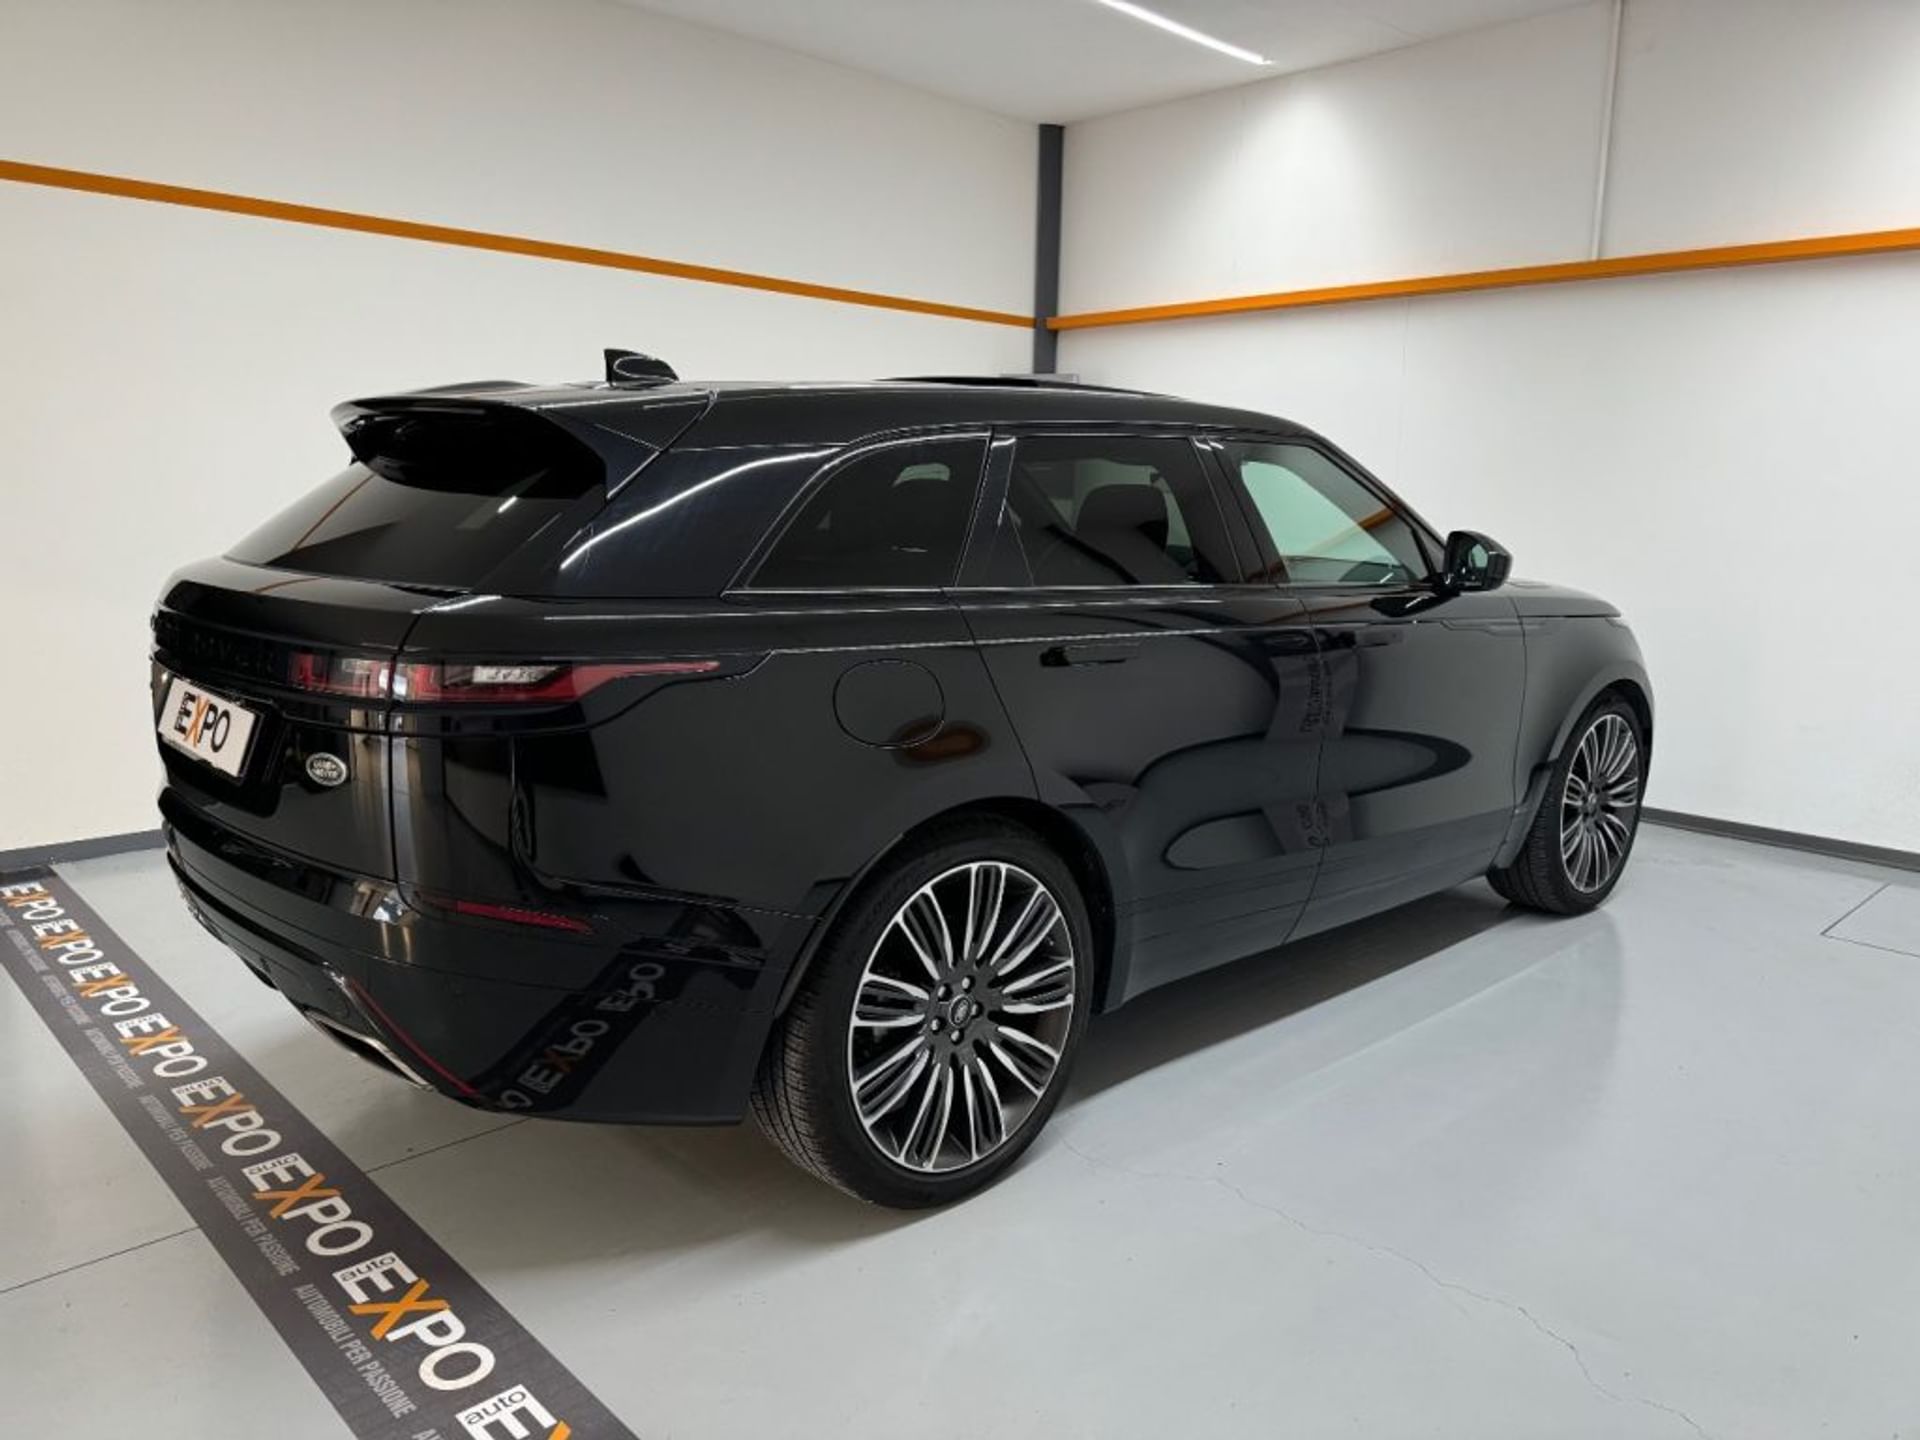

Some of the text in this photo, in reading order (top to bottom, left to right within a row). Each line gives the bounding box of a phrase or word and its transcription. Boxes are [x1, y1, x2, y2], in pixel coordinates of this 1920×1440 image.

[174, 691, 230, 752] EXPO
[0, 881, 65, 921] EXPO
[31, 918, 104, 965] EXPO
[69, 961, 151, 1016] EXPO
[113, 1012, 208, 1077] EXPO
[171, 1076, 282, 1156] EXPO
[241, 1152, 373, 1256] EXPO
[340, 1254, 396, 1283] auto
[332, 1251, 496, 1391] EXPO
[293, 1283, 417, 1419] AUTOMOBILI PER PASSIONE
[455, 1384, 571, 1440] E
[465, 1390, 527, 1425] auto
